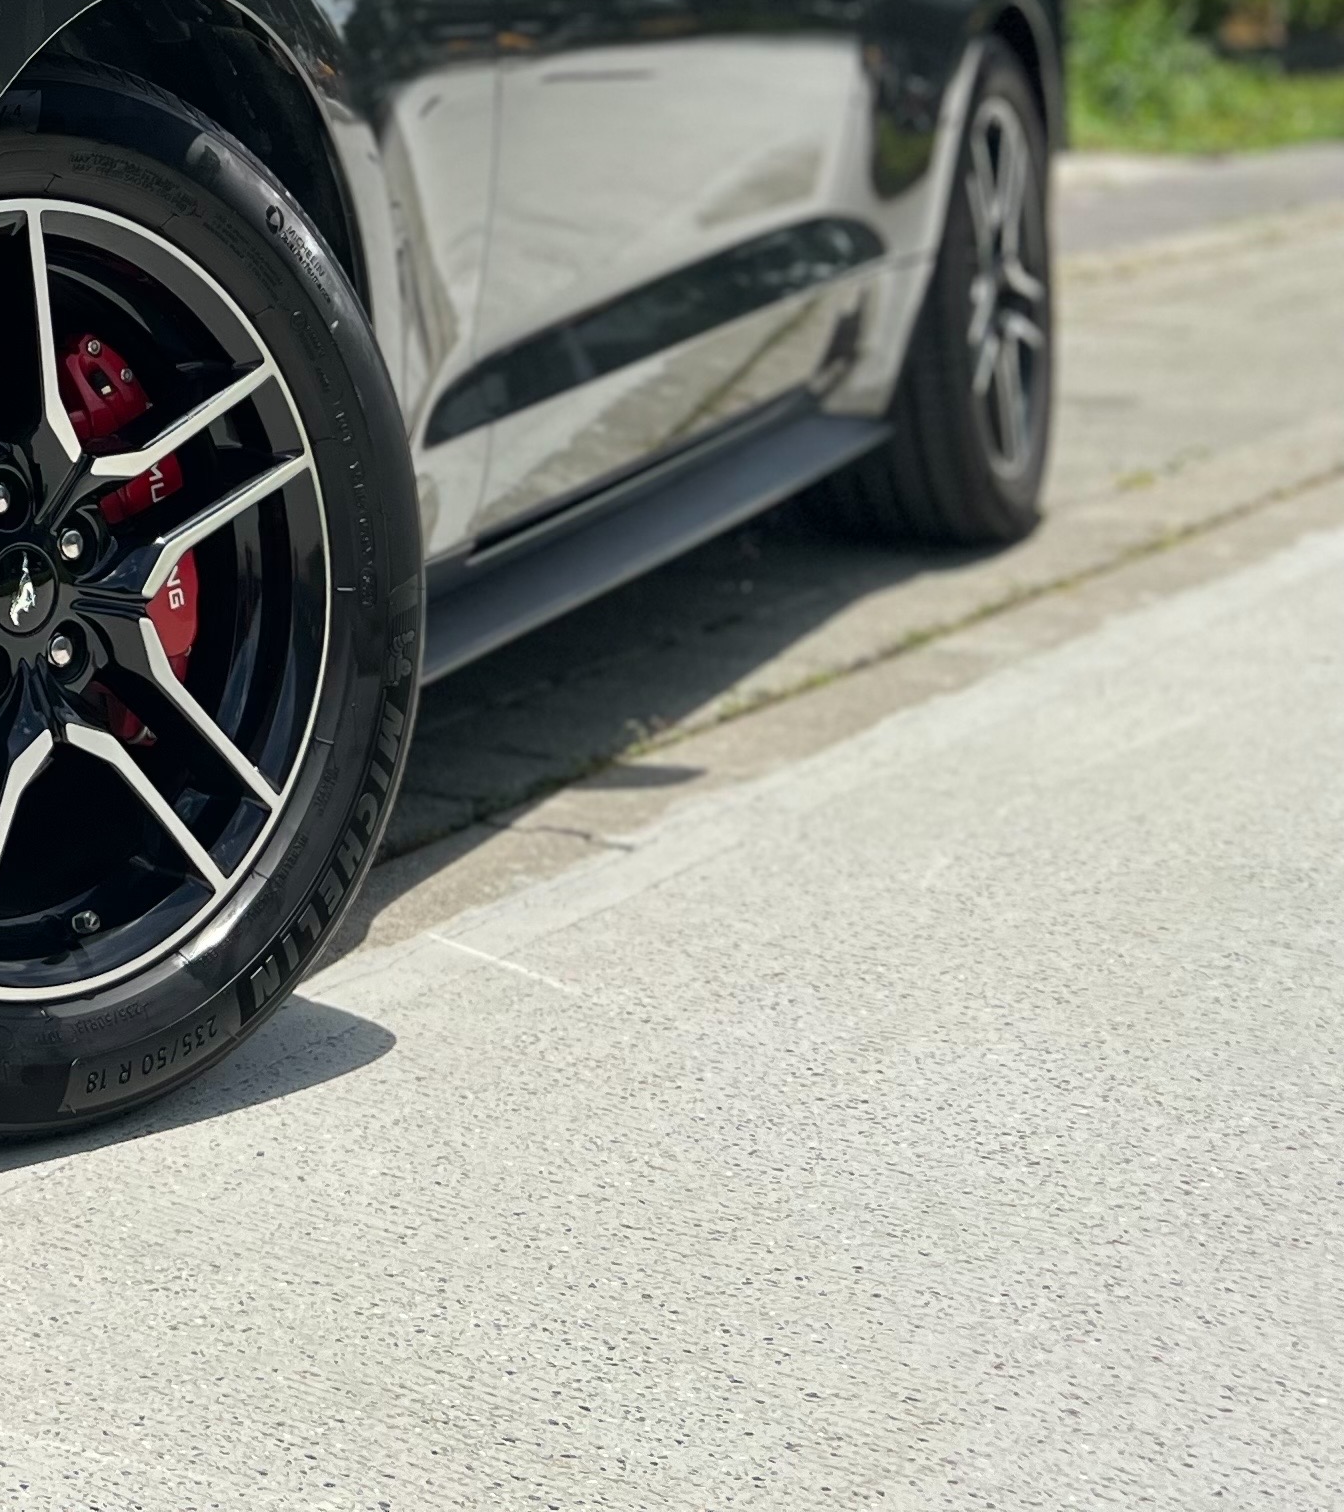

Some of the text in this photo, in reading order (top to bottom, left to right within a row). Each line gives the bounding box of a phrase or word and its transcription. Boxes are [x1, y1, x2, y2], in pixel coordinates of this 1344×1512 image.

[249, 700, 406, 1010] MICHELIN
[86, 1014, 219, 1095] 235/50 R 18
